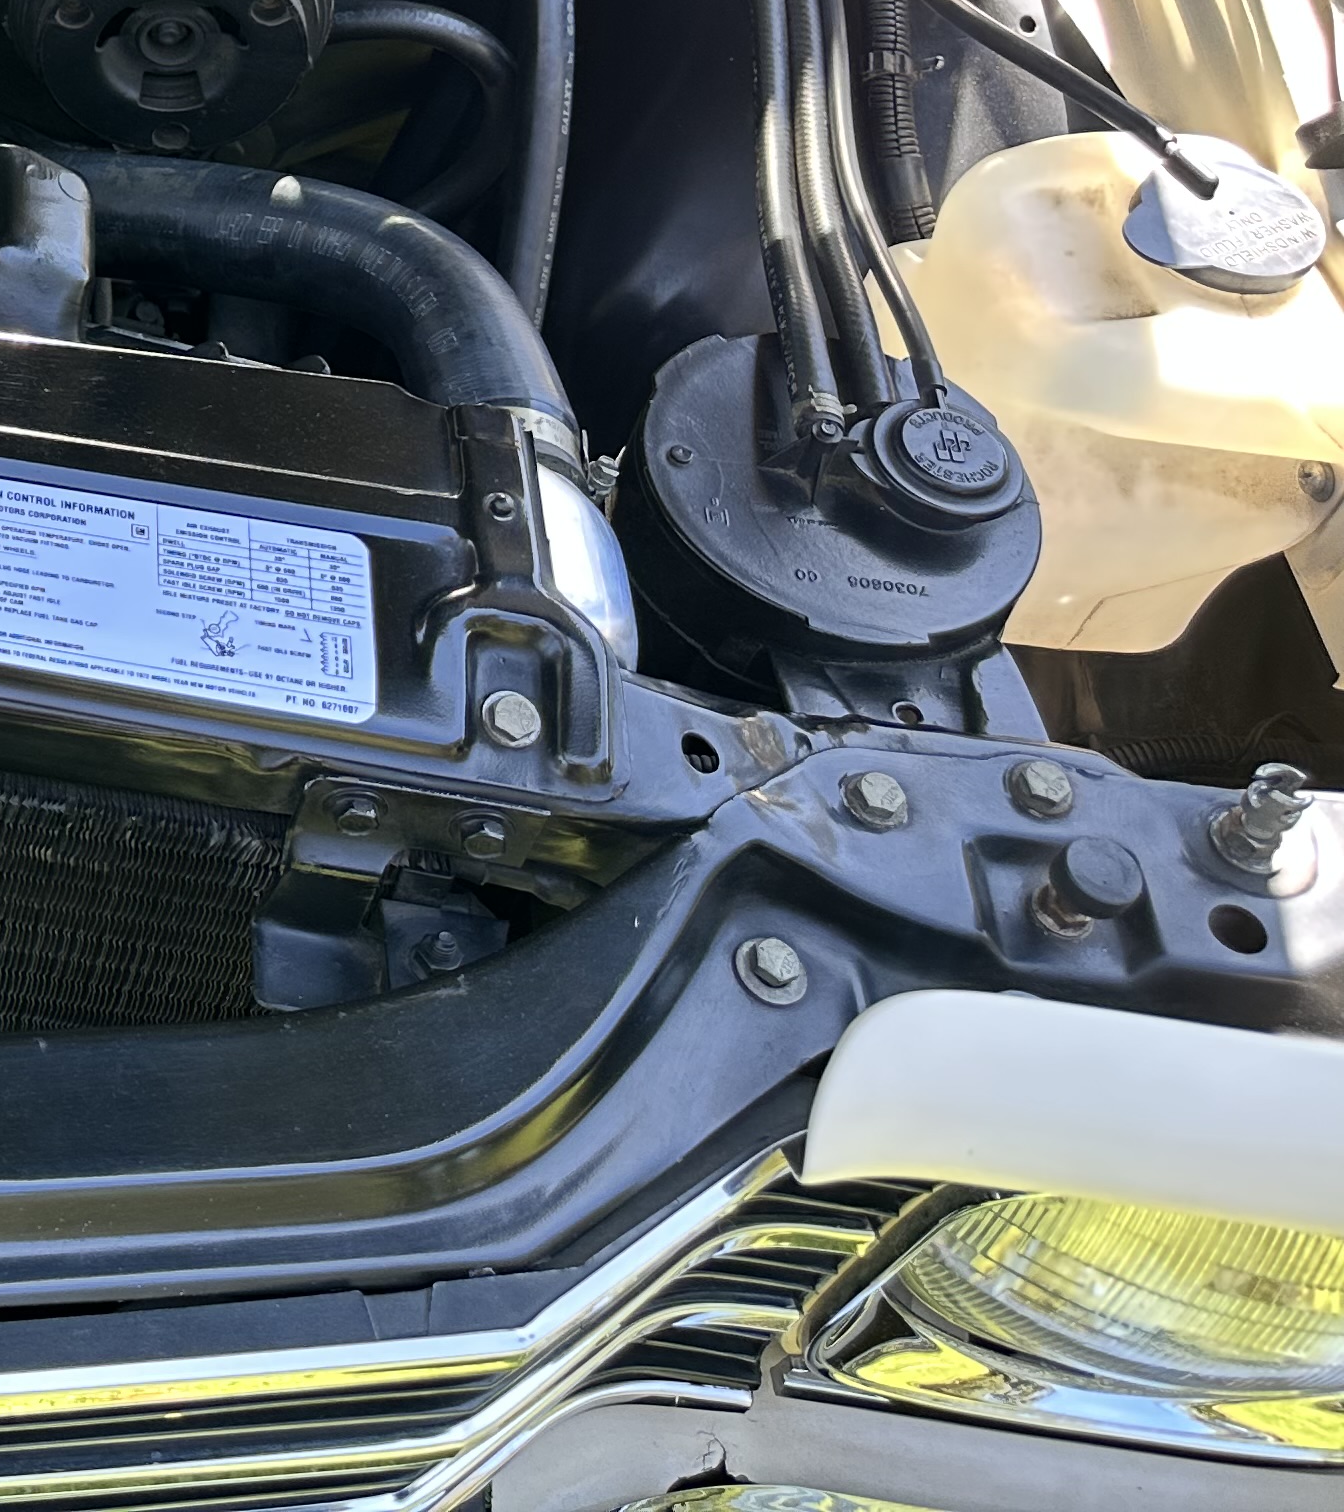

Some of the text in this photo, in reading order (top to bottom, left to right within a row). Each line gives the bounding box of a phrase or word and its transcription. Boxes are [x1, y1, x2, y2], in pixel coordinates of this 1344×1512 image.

[547, 211, 558, 243] MADE
[555, 166, 565, 189] USA
[1227, 212, 1263, 231] ONLY
[1200, 211, 1313, 258] WASHER FLUID
[1223, 228, 1317, 267] WINDSHIELD
[7, 491, 56, 507] CONTROL
[60, 500, 134, 520] INFORMATION
[28, 510, 86, 525] CORPORATION
